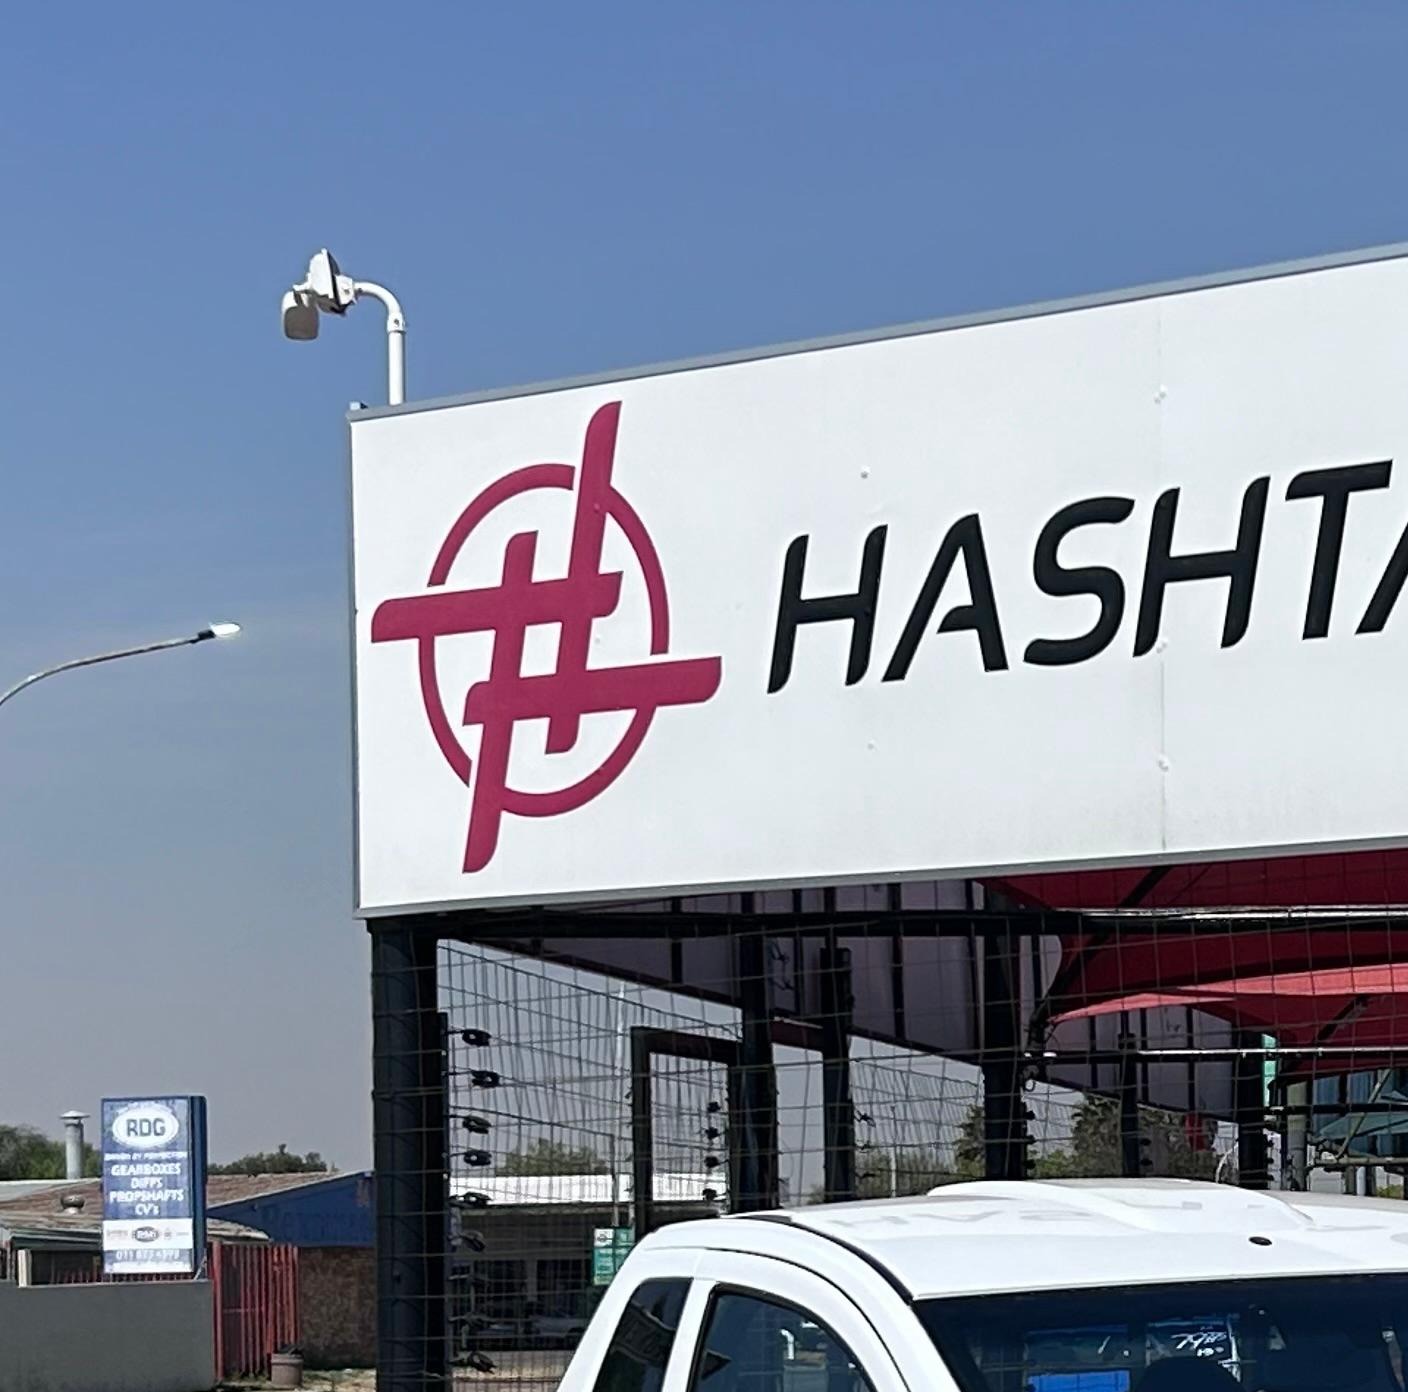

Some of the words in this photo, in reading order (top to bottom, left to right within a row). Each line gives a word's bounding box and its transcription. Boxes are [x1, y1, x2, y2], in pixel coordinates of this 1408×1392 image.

[126, 1118, 166, 1138] RDG
[111, 1163, 181, 1176] GEARBOXES
[130, 1178, 163, 1189] DIFFS
[109, 1190, 184, 1203] PROPSHAFTS
